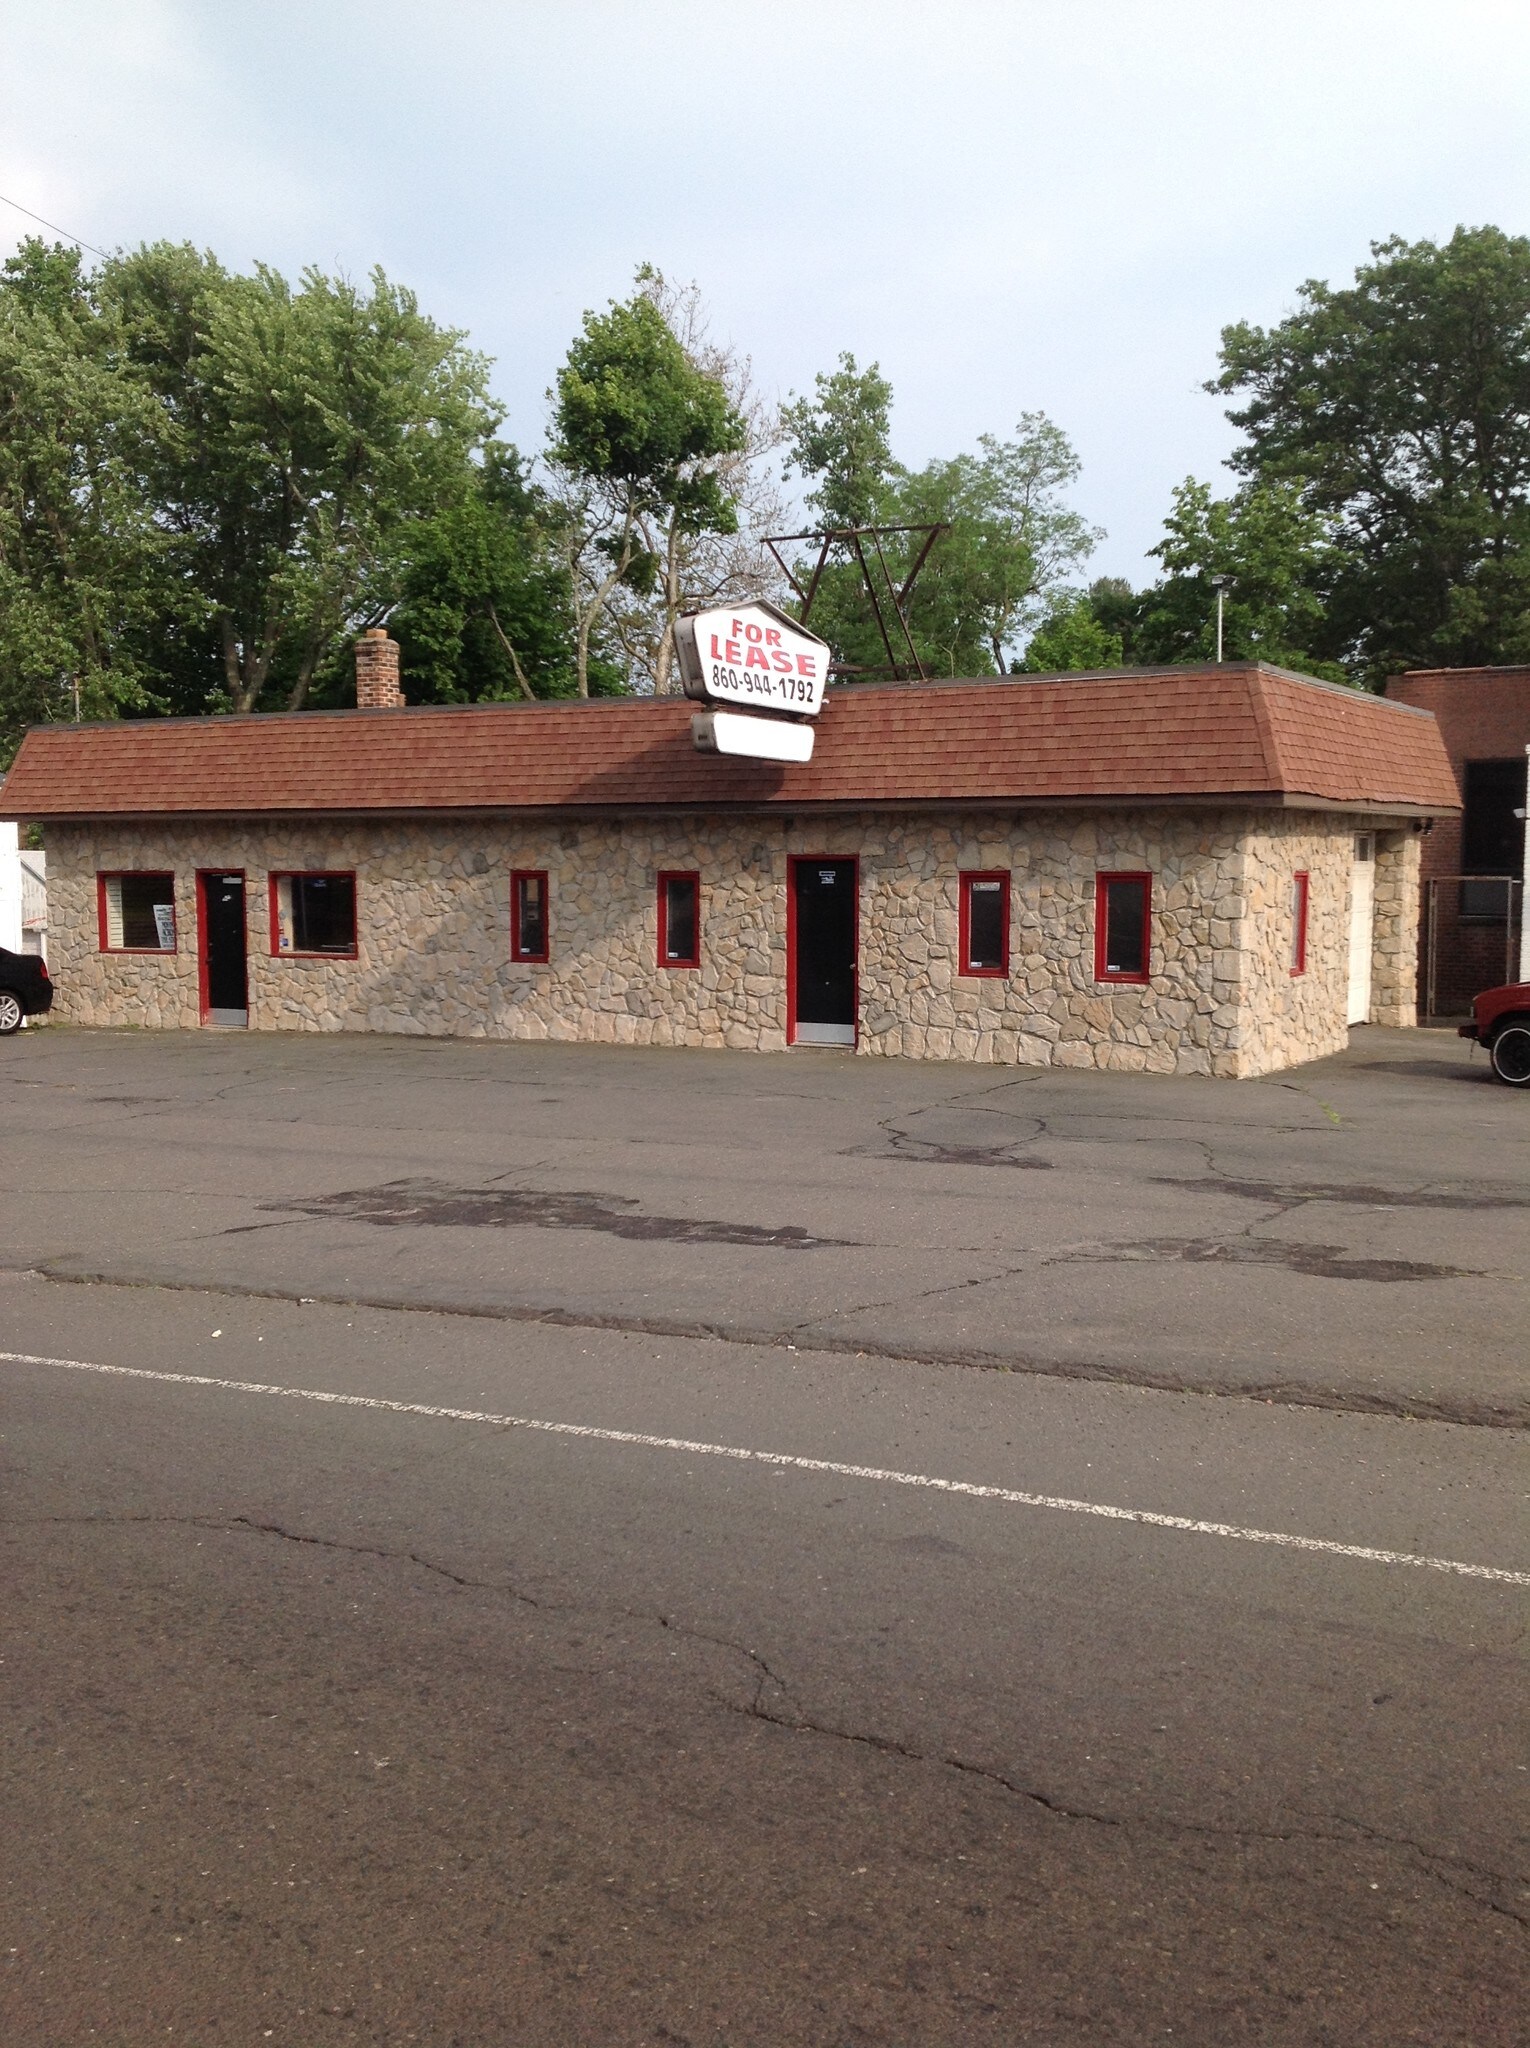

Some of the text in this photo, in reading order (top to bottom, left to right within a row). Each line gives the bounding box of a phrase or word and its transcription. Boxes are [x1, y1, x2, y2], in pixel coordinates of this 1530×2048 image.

[731, 618, 782, 648] FOR
[711, 634, 816, 677] LEASE
[713, 664, 814, 703] 860-944-1792
